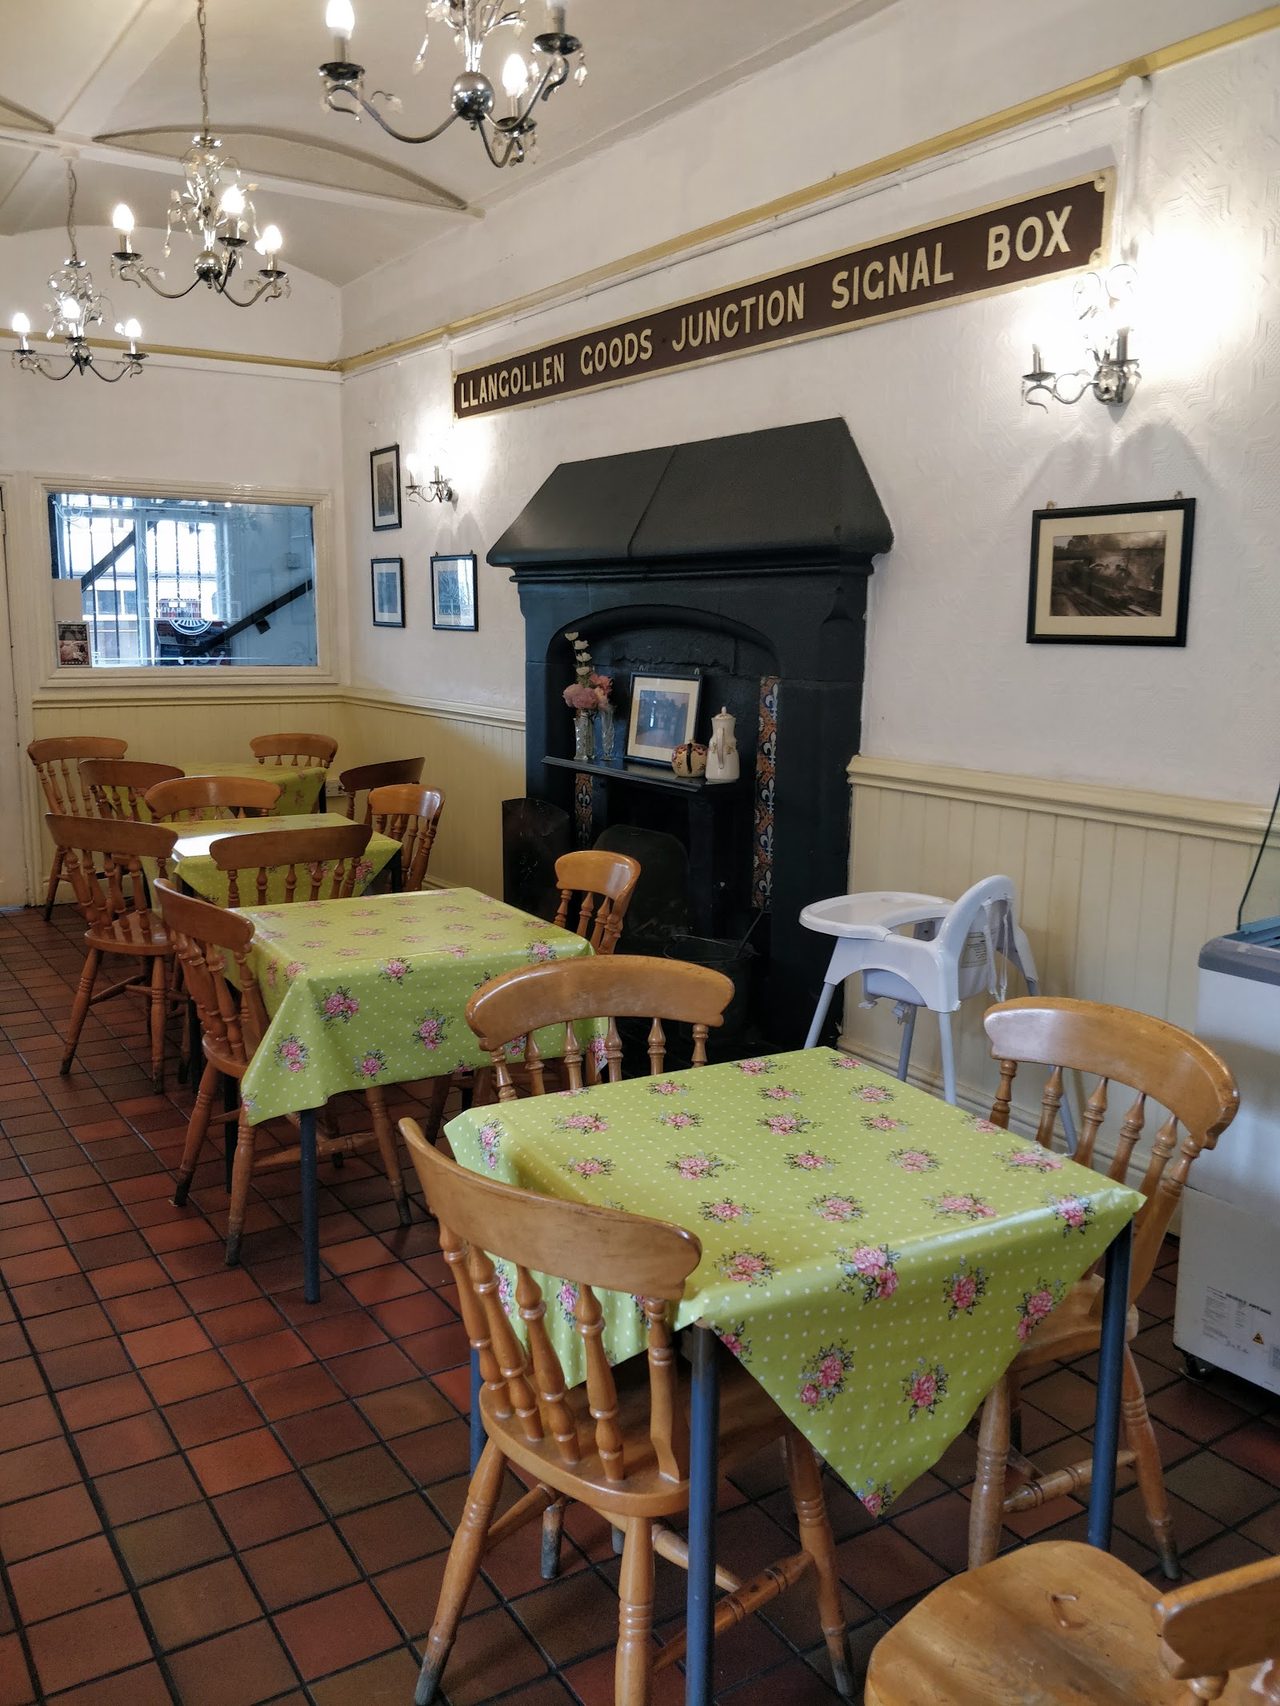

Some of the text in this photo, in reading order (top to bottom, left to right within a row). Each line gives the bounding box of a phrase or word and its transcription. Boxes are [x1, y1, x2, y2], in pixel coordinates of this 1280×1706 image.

[460, 205, 1073, 409] LLANGOLLEN GOODS JUNCTION SIGNAL BOX
